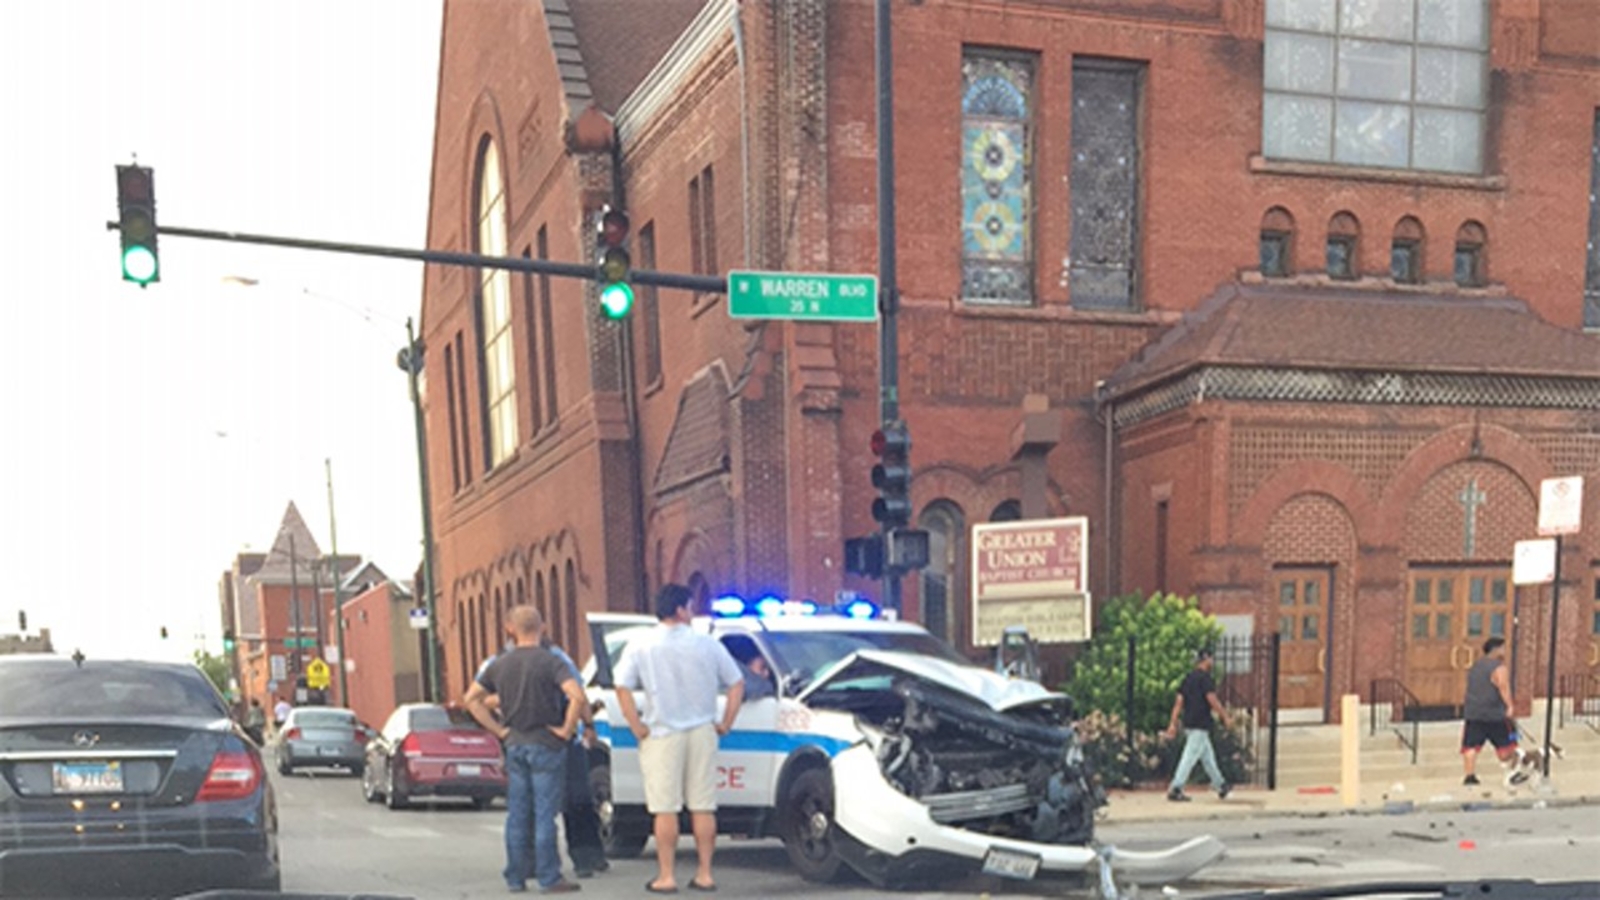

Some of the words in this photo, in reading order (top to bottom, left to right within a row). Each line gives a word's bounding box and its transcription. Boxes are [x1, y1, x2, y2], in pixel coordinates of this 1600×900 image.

[760, 279, 830, 298] WARREN
[979, 530, 1057, 550] GREATER
[987, 549, 1047, 569] UNION
